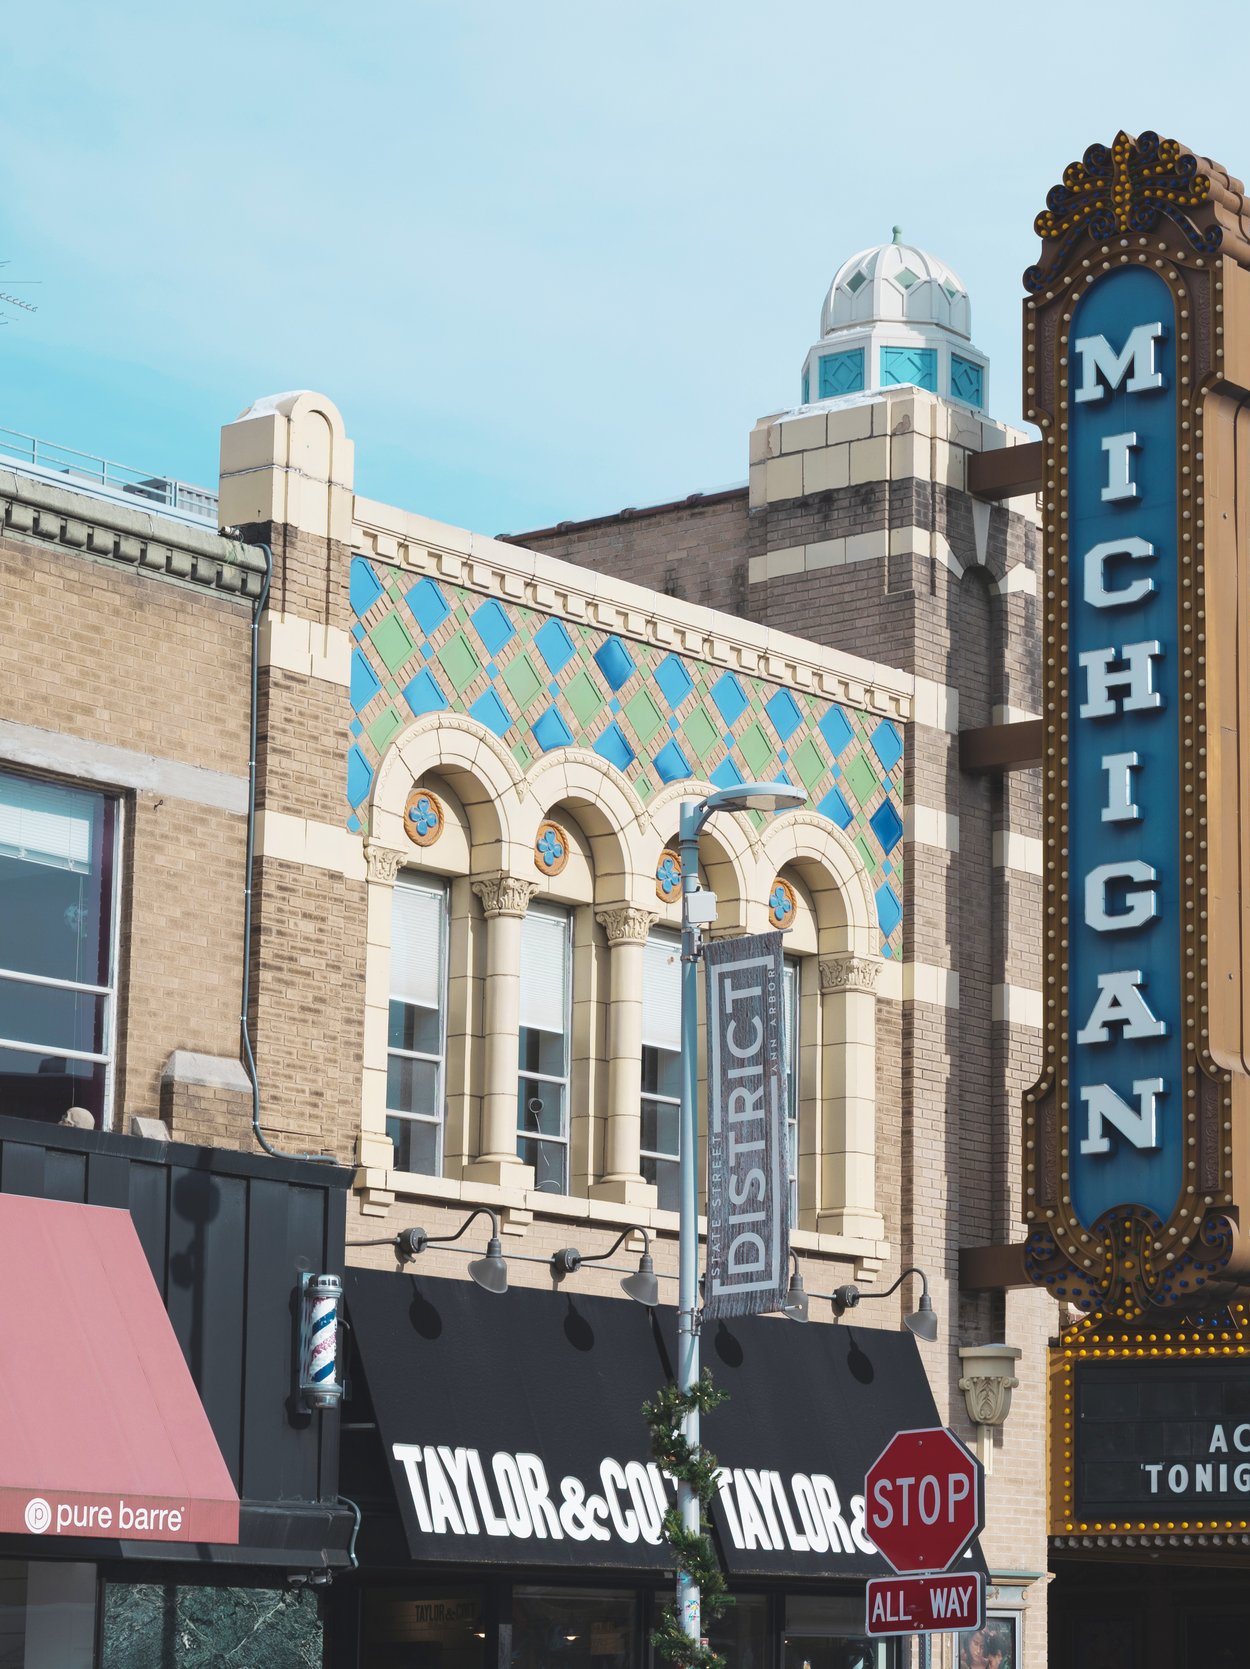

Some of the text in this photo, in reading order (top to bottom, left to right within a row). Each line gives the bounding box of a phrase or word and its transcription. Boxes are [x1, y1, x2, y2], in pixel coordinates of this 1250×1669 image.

[1074, 321, 1168, 1155] MICHIGAN
[767, 969, 779, 1072] ANN ARBOR
[725, 977, 766, 1275] DISTRICT
[711, 1136, 722, 1277] STATE STREET
[57, 1503, 113, 1533] pure
[872, 1472, 970, 1529] STOP
[871, 1585, 974, 1623] ALL WAY
